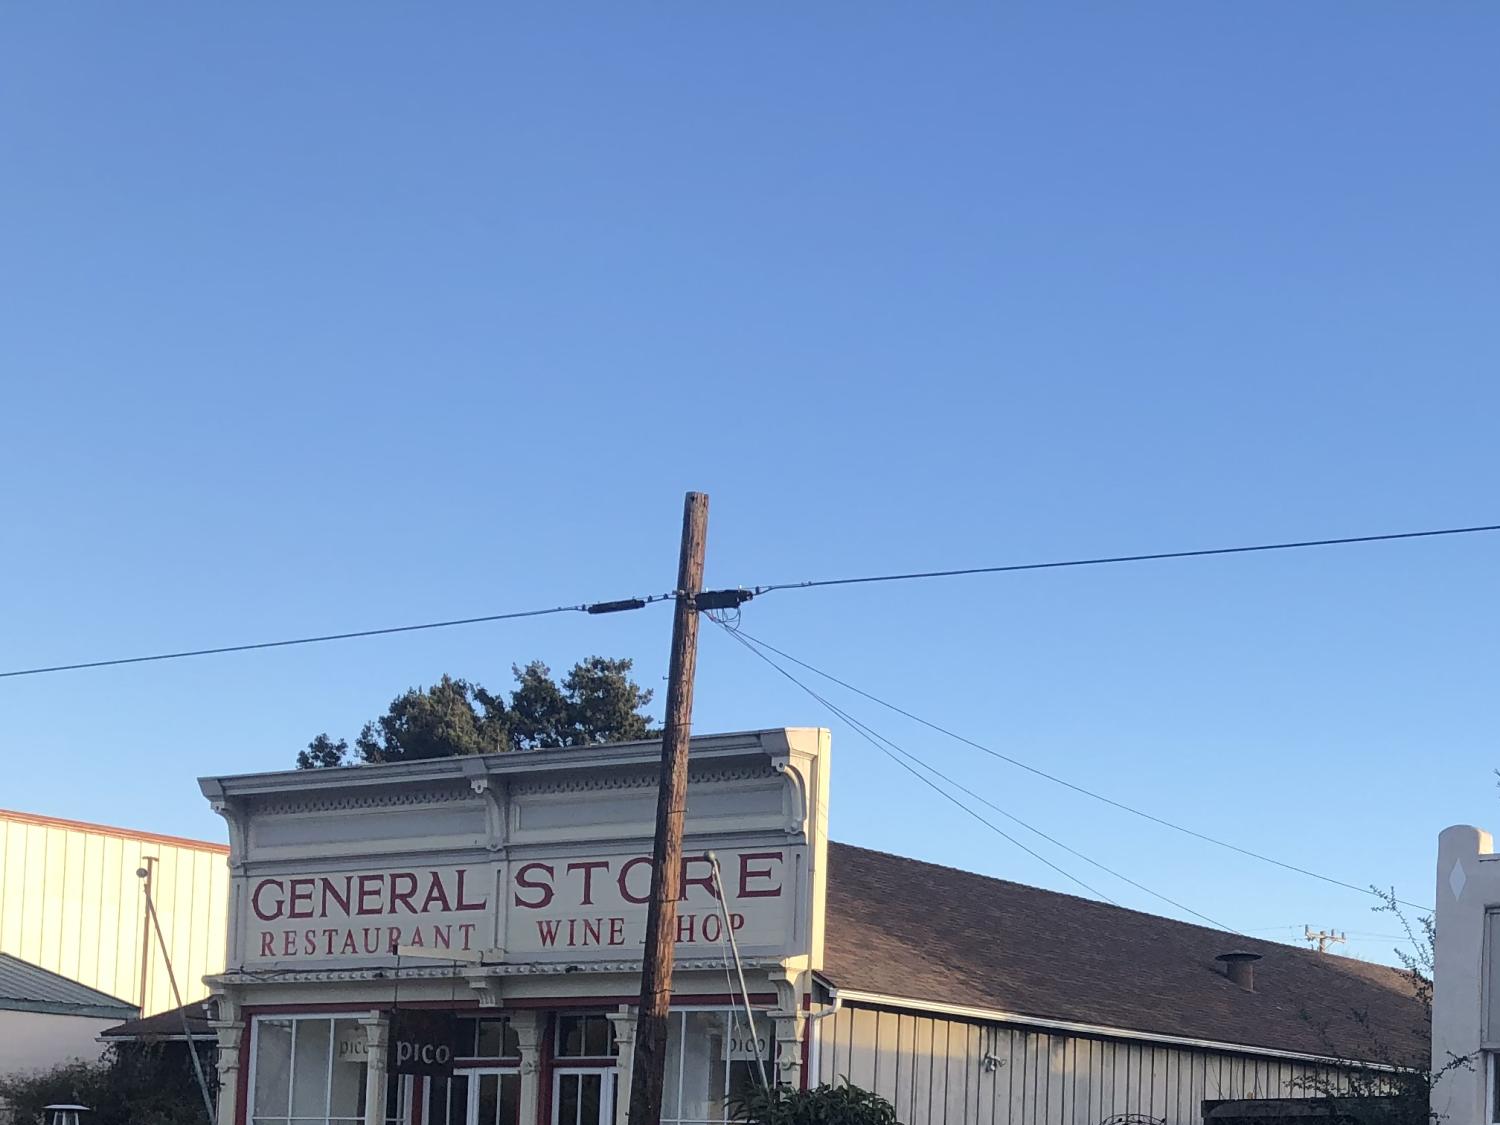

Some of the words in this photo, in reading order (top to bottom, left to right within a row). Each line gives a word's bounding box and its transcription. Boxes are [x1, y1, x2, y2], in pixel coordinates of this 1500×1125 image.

[252, 869, 488, 921] GENERAL
[514, 852, 784, 909] STORE
[260, 923, 476, 957] RESTAURANT
[536, 917, 625, 947] WINE
[639, 913, 745, 945] HOP
[396, 1040, 450, 1066] pico
